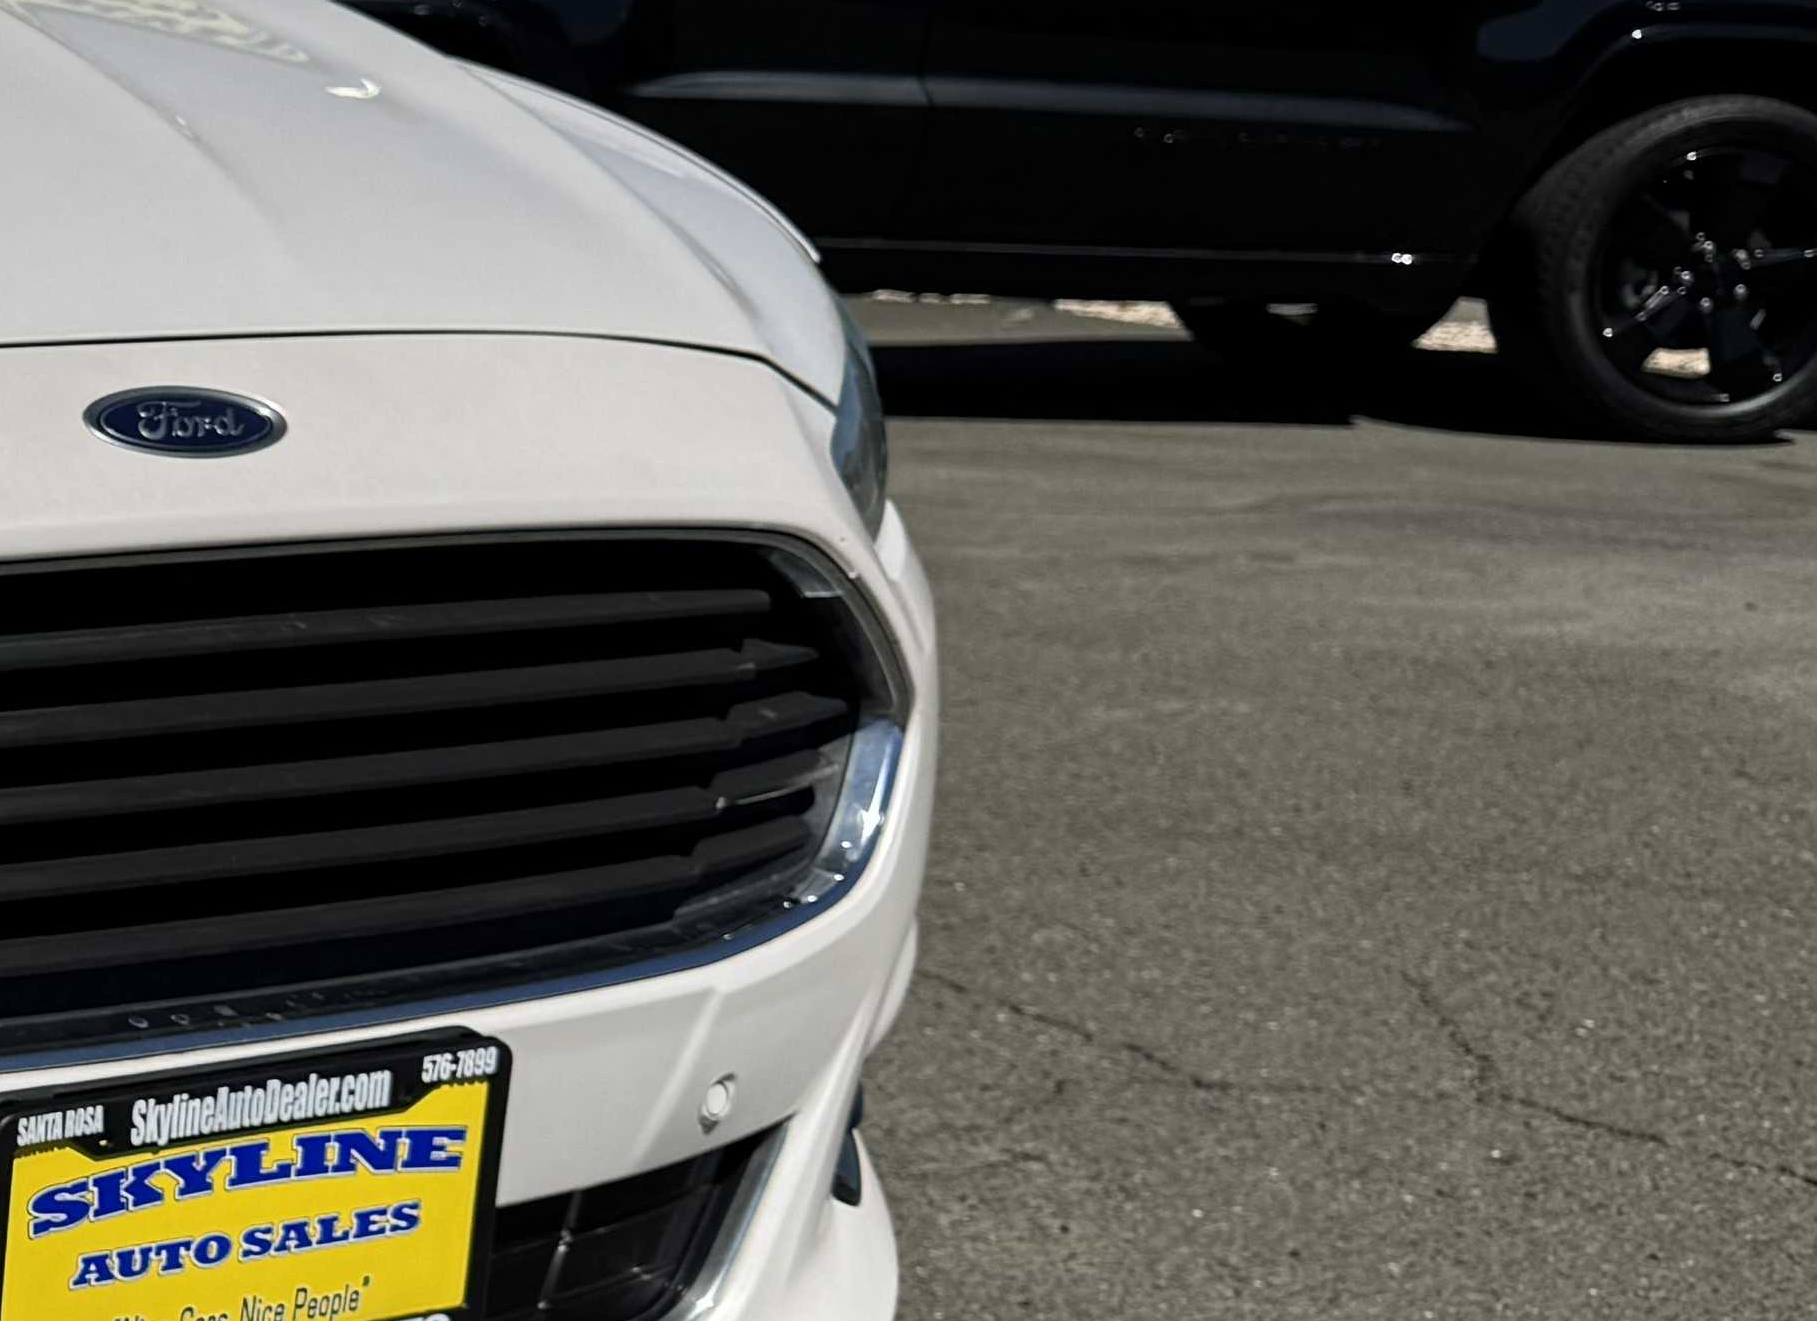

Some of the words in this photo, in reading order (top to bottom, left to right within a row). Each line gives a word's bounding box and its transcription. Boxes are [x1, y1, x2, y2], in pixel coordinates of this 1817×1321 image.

[136, 400, 245, 441] Ford
[421, 1046, 499, 1083] 576-7899
[17, 1109, 62, 1147] SANTA
[64, 1105, 104, 1138] ROSA
[131, 1070, 391, 1148] SkylineAutoDealer.com
[27, 1126, 468, 1240] SKYLINE
[68, 1235, 232, 1292] AUTO
[239, 1199, 422, 1261] SALES
